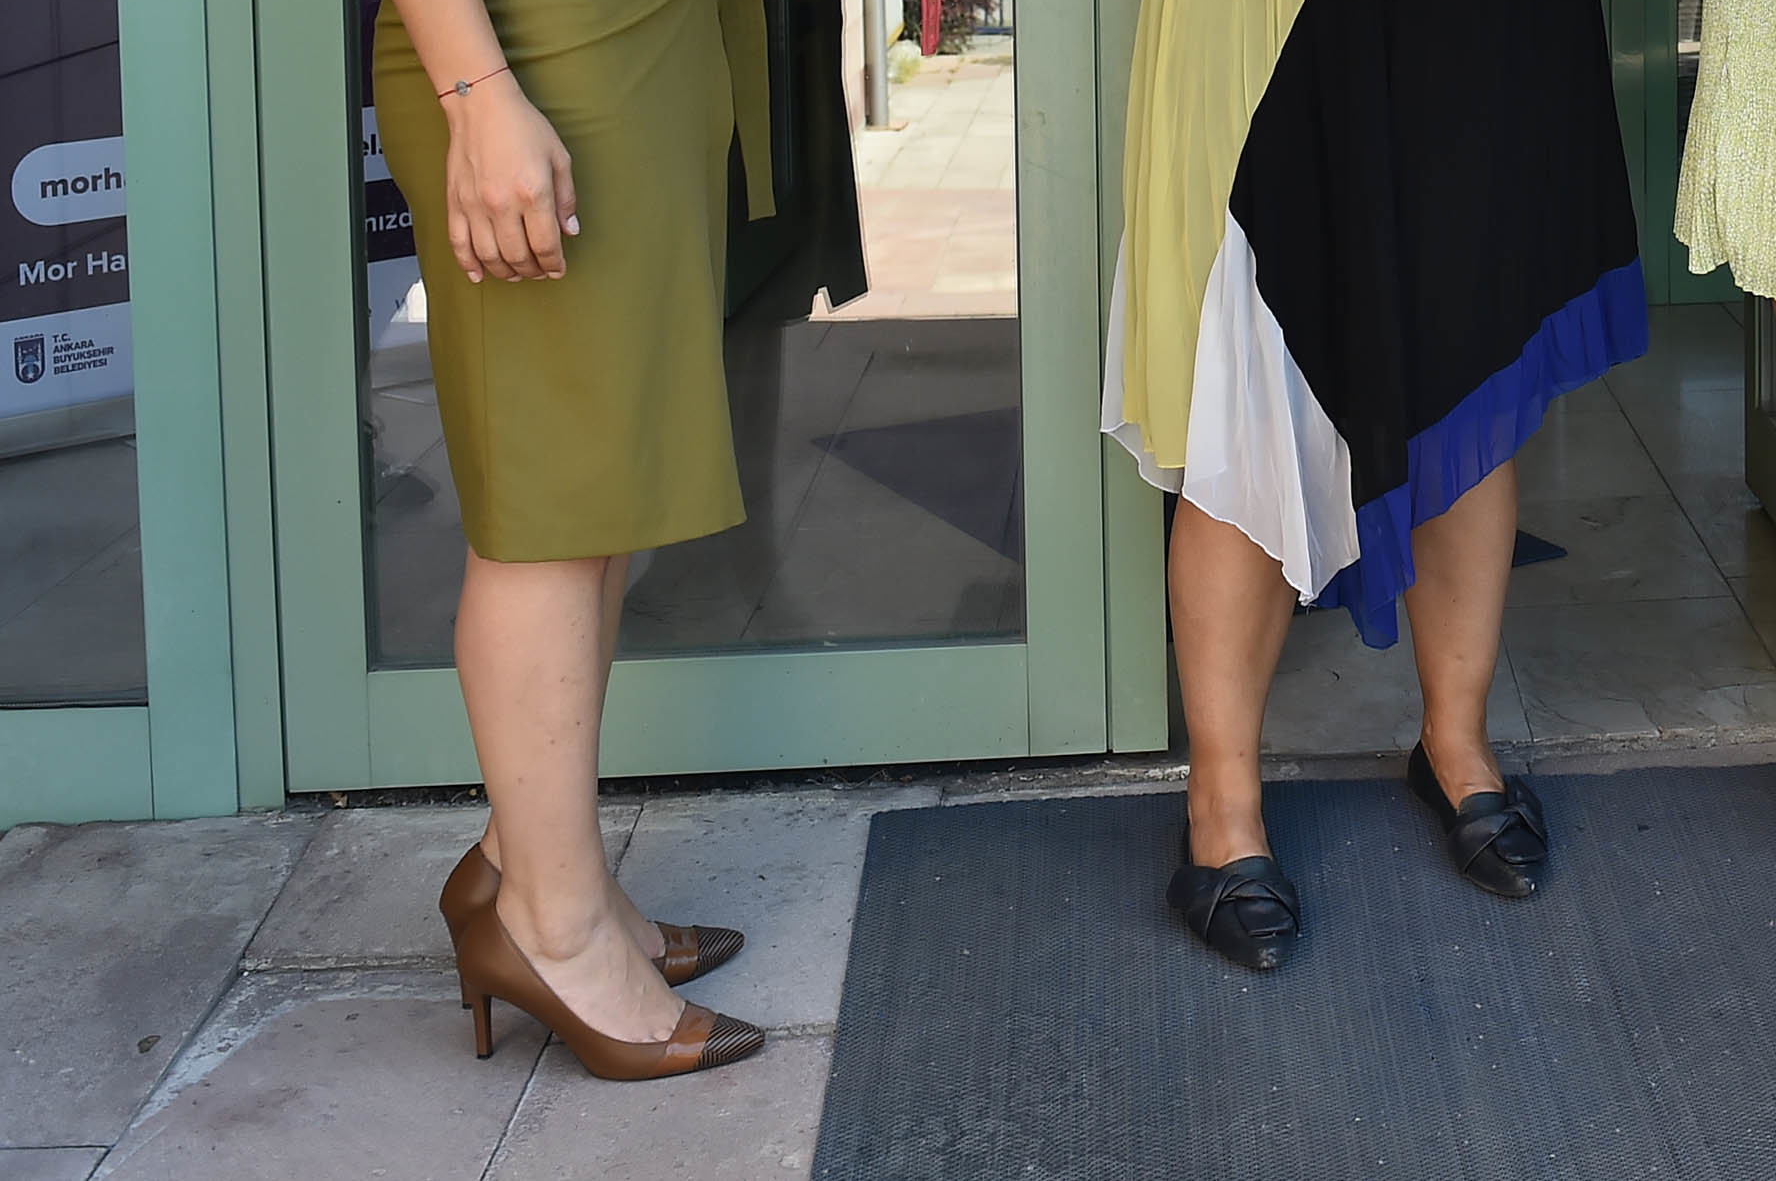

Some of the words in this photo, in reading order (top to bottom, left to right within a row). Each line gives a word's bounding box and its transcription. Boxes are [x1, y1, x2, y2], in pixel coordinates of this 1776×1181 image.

[40, 167, 125, 198] morh
[19, 261, 77, 286] Mor
[87, 251, 126, 275] Ha
[52, 333, 71, 343] T.C.
[53, 339, 95, 354] ANKARA
